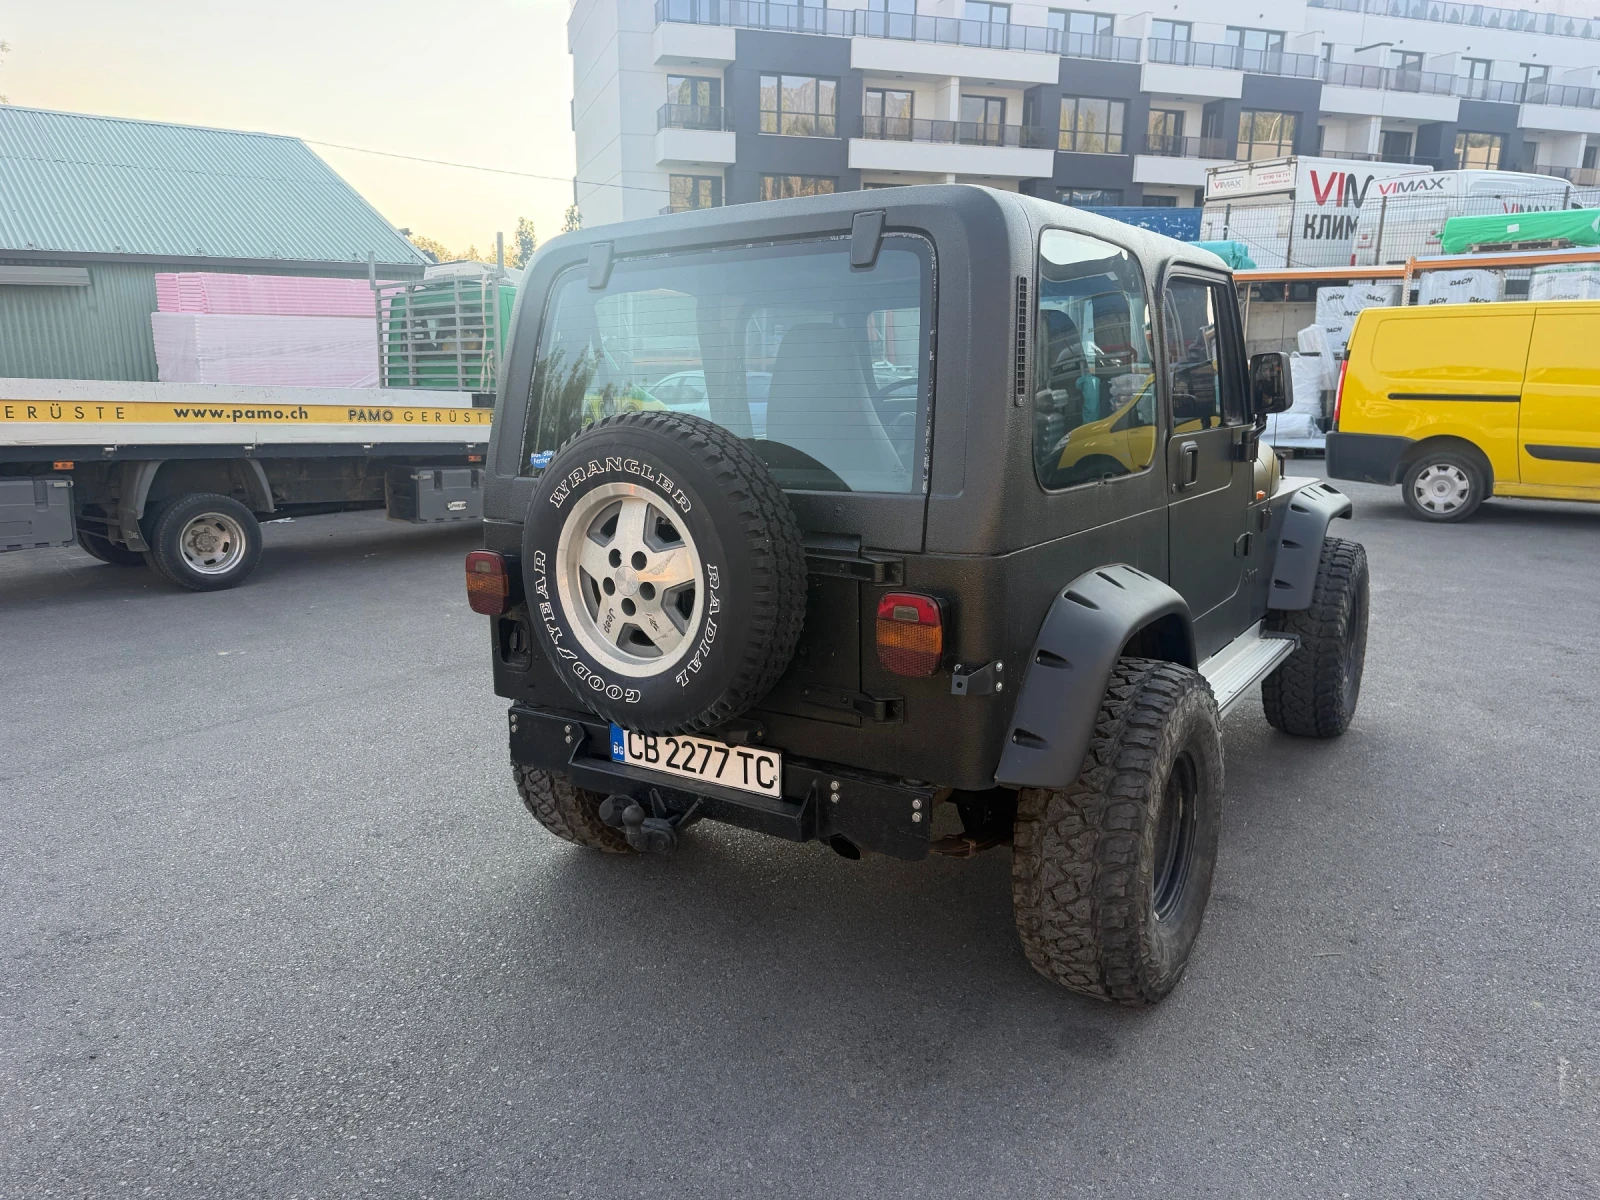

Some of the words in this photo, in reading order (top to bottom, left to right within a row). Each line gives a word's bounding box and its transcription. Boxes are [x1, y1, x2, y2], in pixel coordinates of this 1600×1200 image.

[1214, 180, 1242, 189] VIMAX
[173, 406, 309, 422] www.pamo.ch
[347, 408, 394, 422] PAMO
[549, 456, 692, 513] WRANGLER
[534, 550, 641, 703] GOODYEAR
[602, 607, 616, 634] Jeep
[675, 563, 720, 687] RADIAL
[613, 741, 624, 755] BG
[665, 737, 730, 779] 2277
[737, 751, 775, 789] TC
